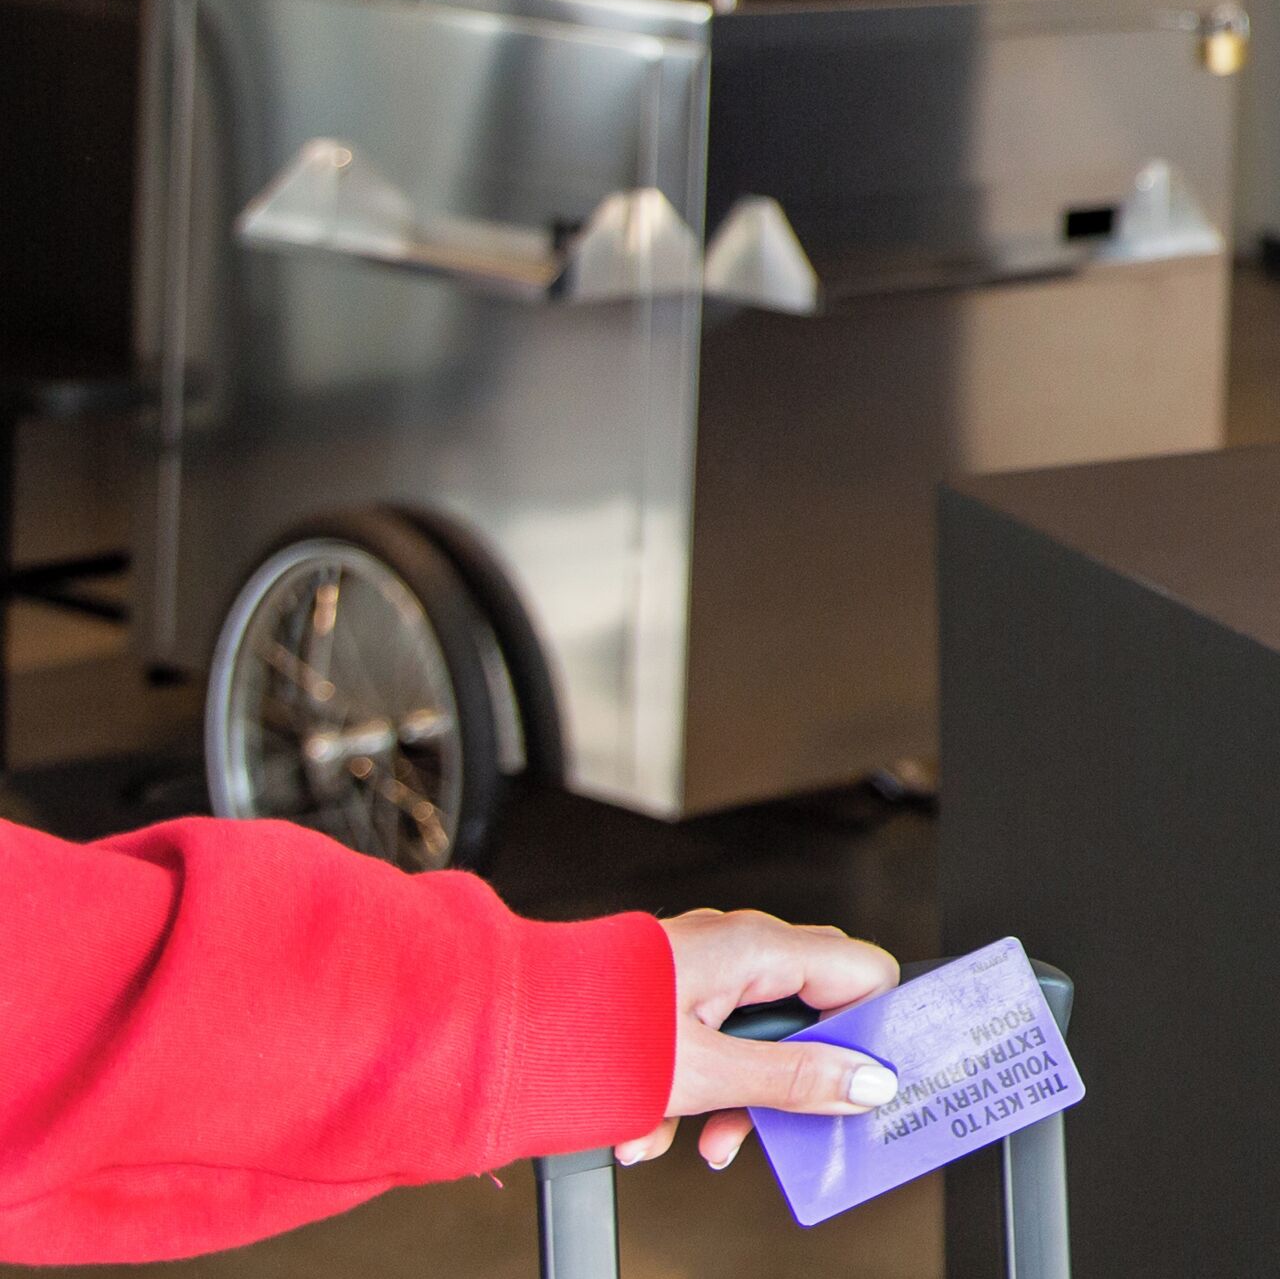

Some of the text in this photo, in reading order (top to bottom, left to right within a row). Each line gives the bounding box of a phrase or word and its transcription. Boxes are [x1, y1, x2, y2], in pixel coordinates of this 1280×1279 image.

[964, 1003, 1036, 1046] ROOM.
[884, 1051, 1058, 1145] YOUR VERY, VERY
[951, 1073, 1068, 1138] THE KEY TO
